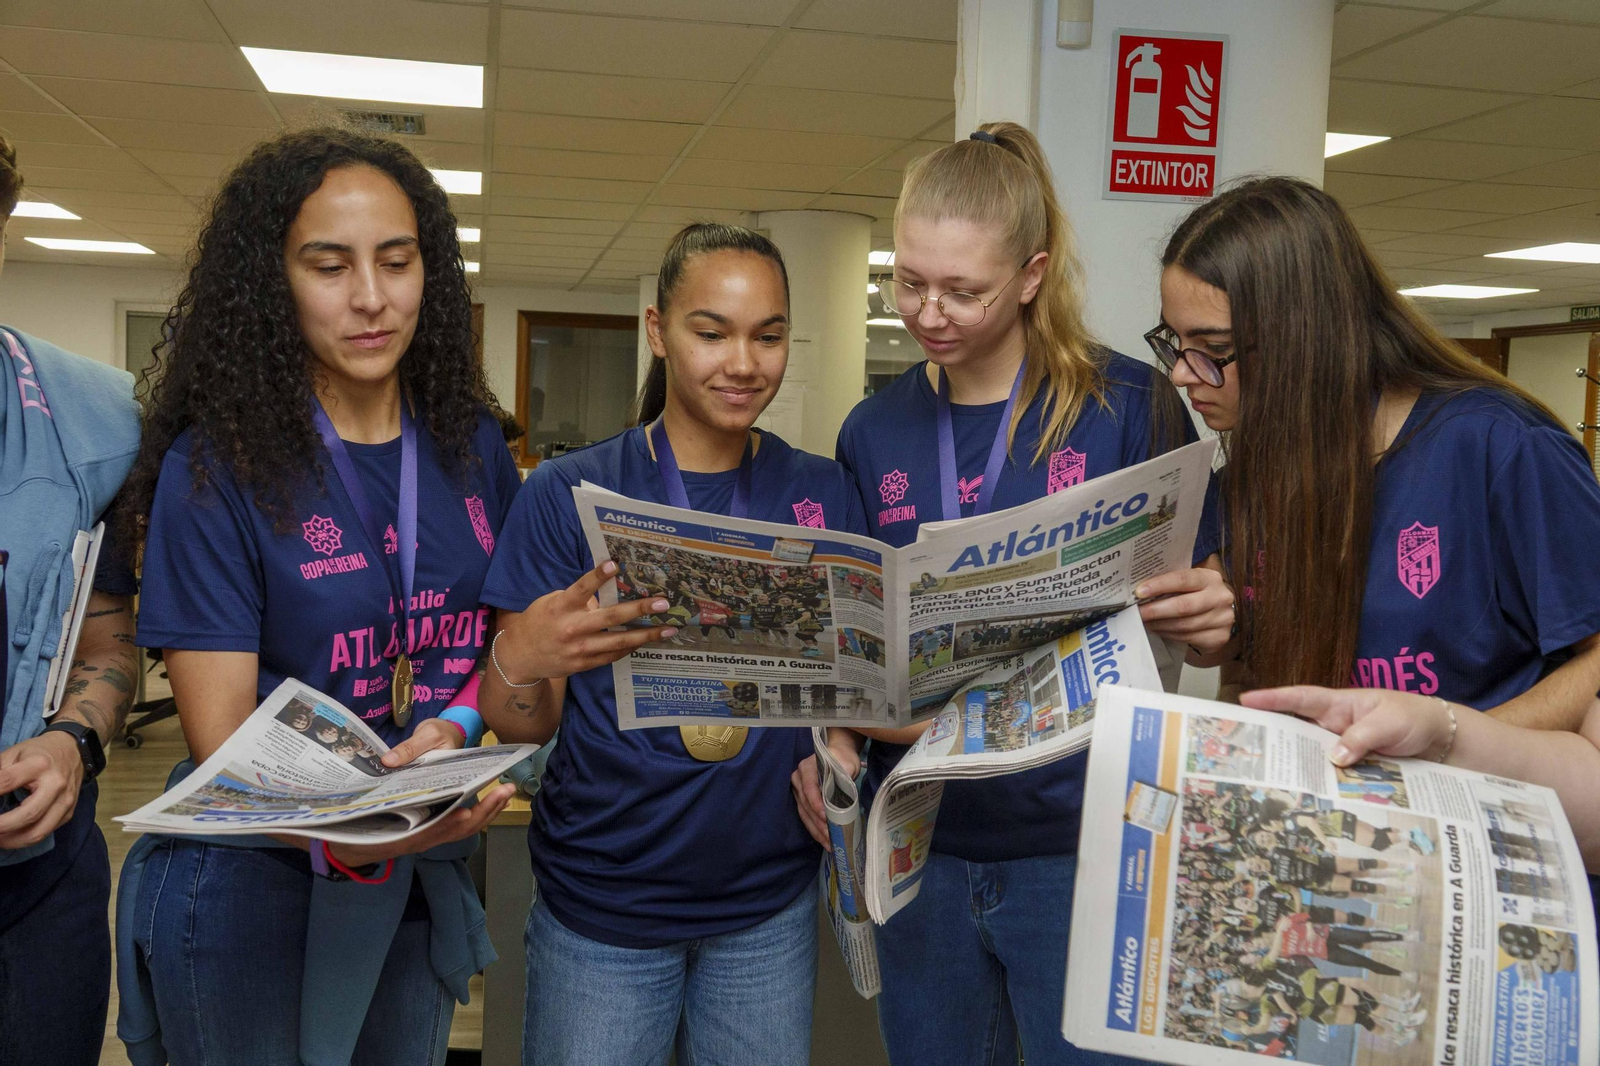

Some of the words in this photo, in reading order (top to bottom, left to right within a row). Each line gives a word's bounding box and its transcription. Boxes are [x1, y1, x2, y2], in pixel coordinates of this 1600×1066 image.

[1115, 158, 1209, 188] EXTINTOR
[1572, 307, 1600, 320] SALIDA
[603, 512, 677, 533] Atlántico
[892, 504, 916, 523] REINA
[604, 524, 626, 534] LOS
[626, 529, 682, 545] DEPORTES
[946, 492, 1149, 573] Atlántico
[300, 559, 332, 580] COPA
[335, 552, 368, 575] REINA
[909, 593, 962, 603] PSOE,
[965, 585, 1003, 597] BNG
[1015, 570, 1068, 590] Sumar
[1069, 550, 1121, 578] pactan
[909, 595, 986, 610] transferir
[1003, 586, 1050, 599] AP-9:
[1051, 570, 1101, 592] Rueda
[909, 605, 962, 618] afirma
[963, 602, 995, 610] que
[330, 626, 381, 673] ATL.
[630, 651, 662, 660] Dulce
[665, 653, 704, 662] resaca
[706, 655, 758, 666] histórica
[789, 660, 833, 671] Guarda
[1085, 614, 1126, 688] ántico
[654, 677, 688, 685] TIENDA
[920, 665, 955, 681] céltico
[956, 658, 984, 670] Borja
[251, 759, 278, 775] Copa
[276, 764, 315, 783] historia
[279, 772, 293, 782] de
[1445, 824, 1462, 873] Guarda
[1450, 877, 1463, 889] A
[1452, 892, 1463, 911] en
[1446, 915, 1463, 985] histórica
[1113, 936, 1139, 1025] Atlántico
[1143, 937, 1159, 1001] DEPORTES
[1497, 970, 1510, 1017] LATINA
[1142, 1003, 1153, 1031] LOS
[1446, 987, 1460, 1041] resaca
[1440, 1043, 1457, 1066] lce
[1495, 1019, 1508, 1066] TIENDA
